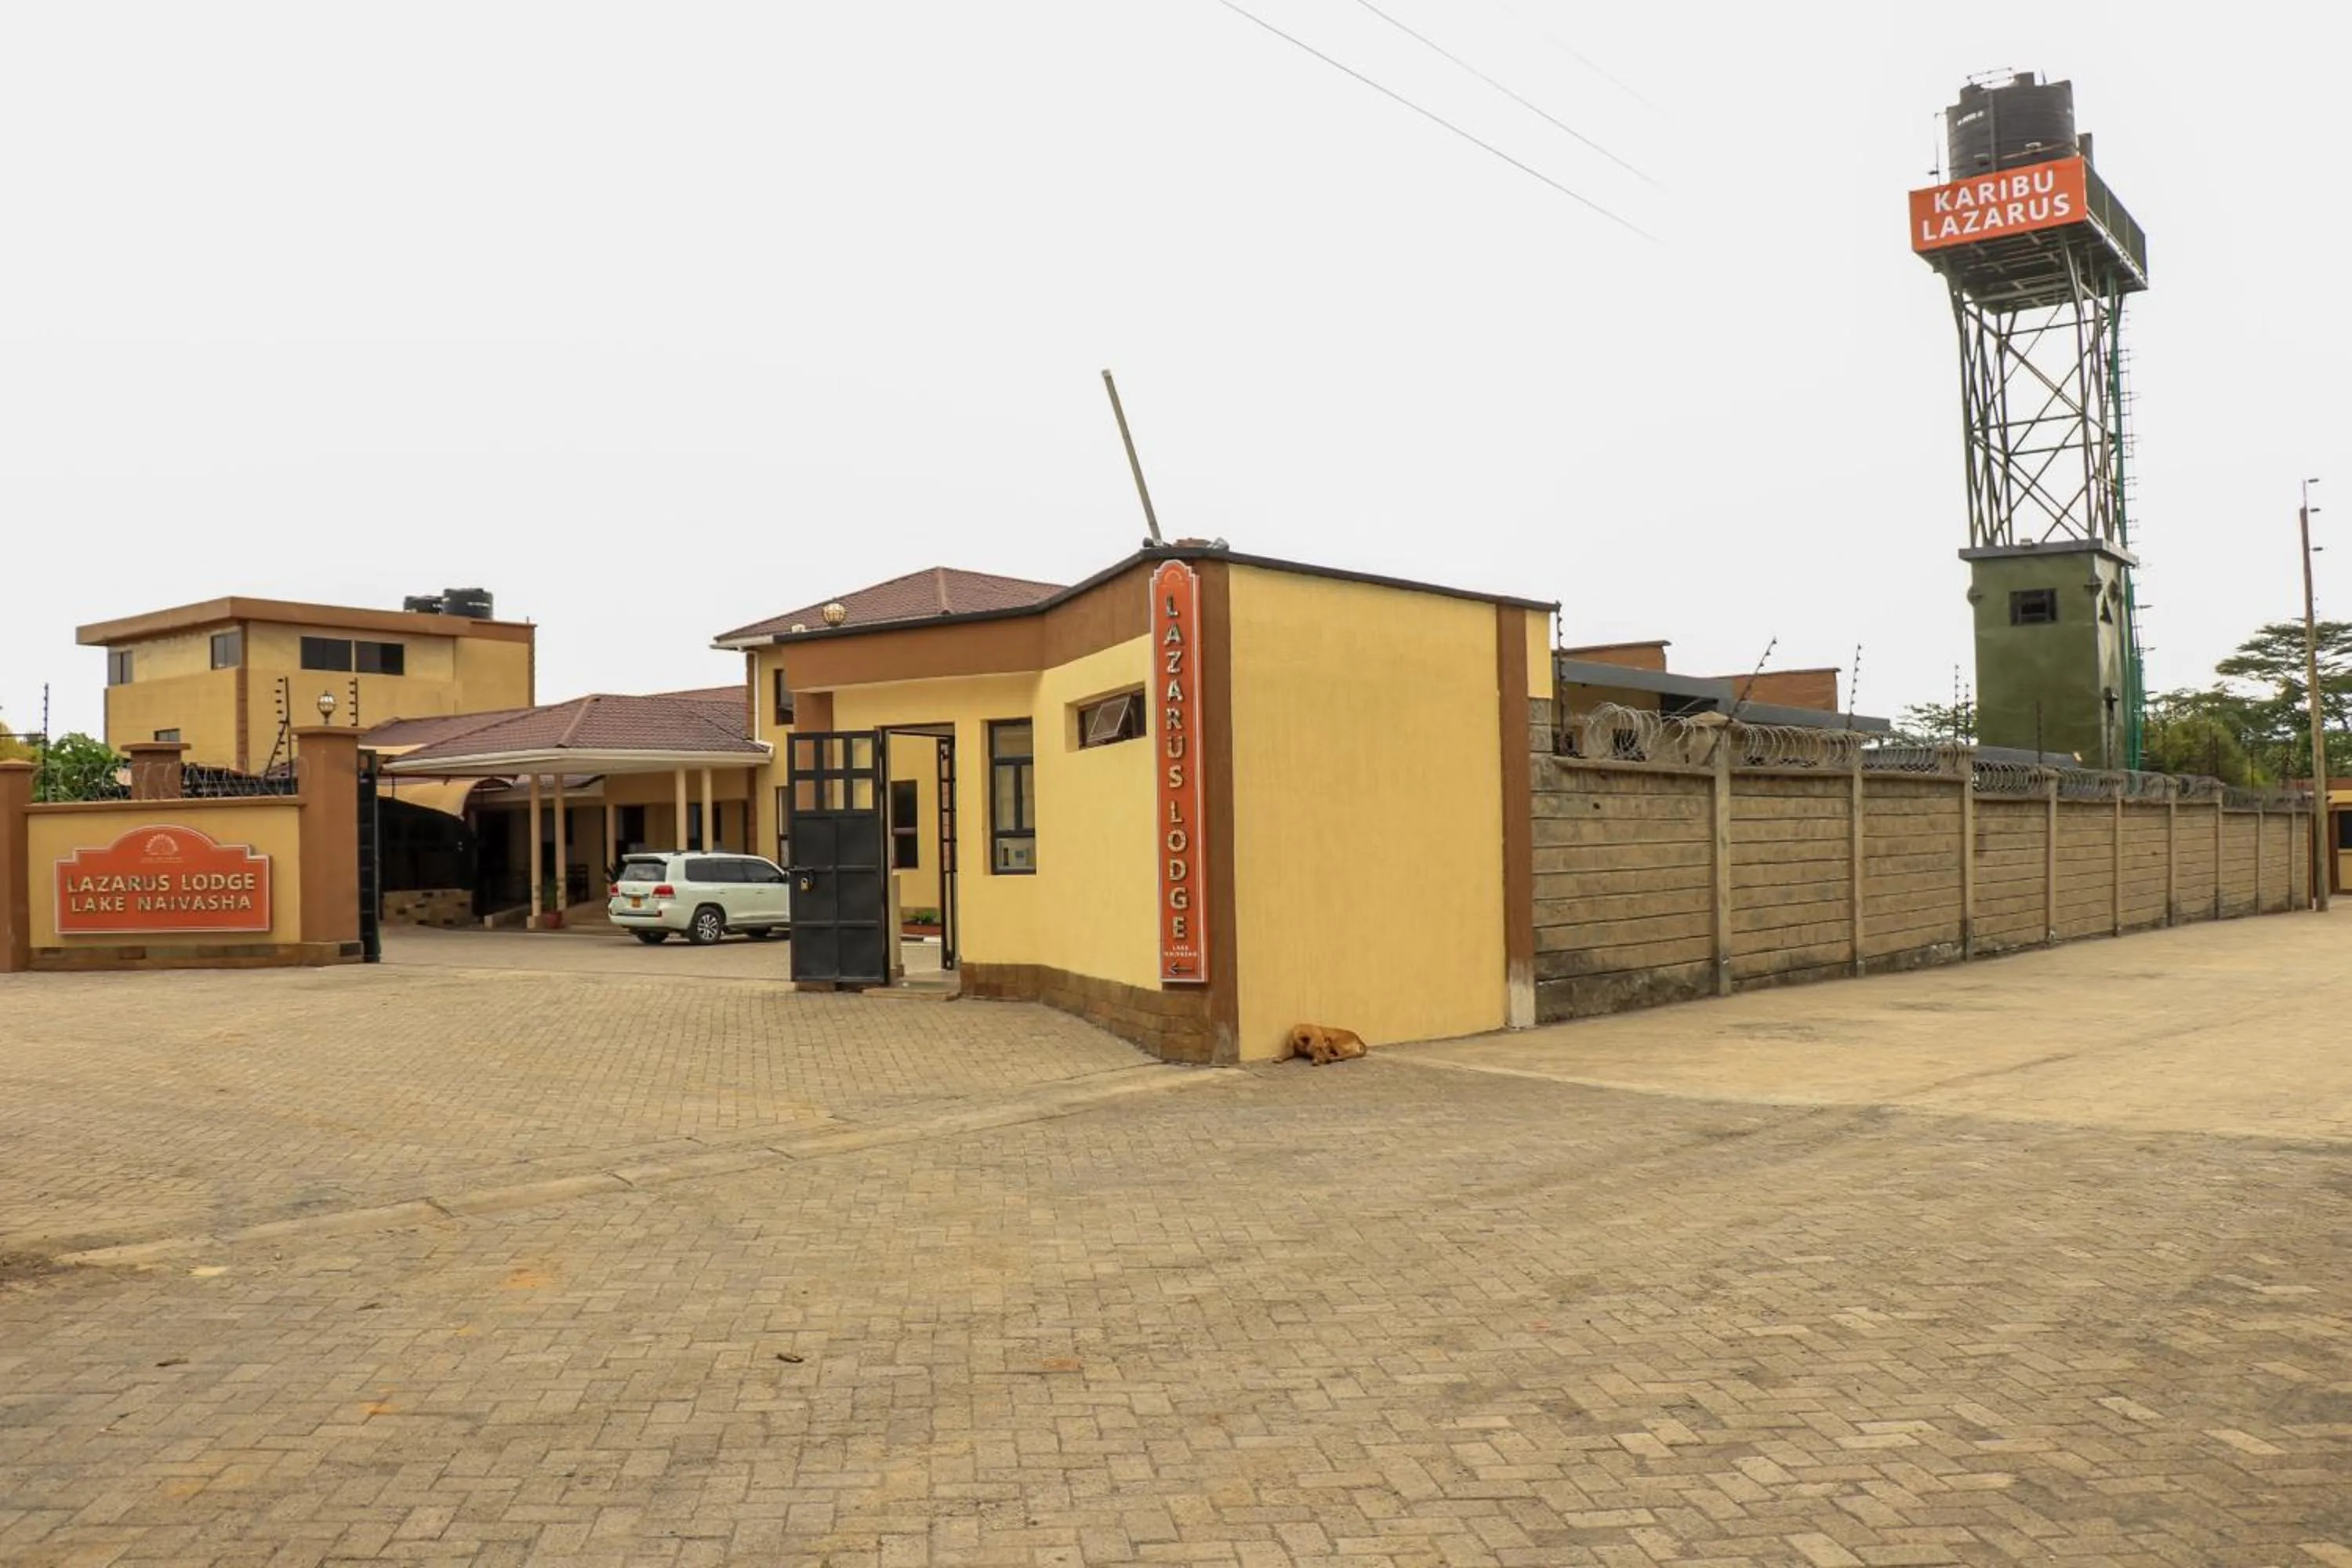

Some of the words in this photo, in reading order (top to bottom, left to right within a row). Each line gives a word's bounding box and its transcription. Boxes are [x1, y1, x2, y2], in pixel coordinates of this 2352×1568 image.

[1934, 170, 2054, 213] KARIBU
[1922, 194, 2071, 241] LAZARUS
[1163, 595, 1184, 788] LAZARUS
[67, 874, 170, 893] LAZARUS
[181, 873, 256, 891] LODGE
[1167, 800, 1189, 938] LODGE
[71, 897, 125, 913] LAKE
[137, 895, 252, 911] NAIVASHA
